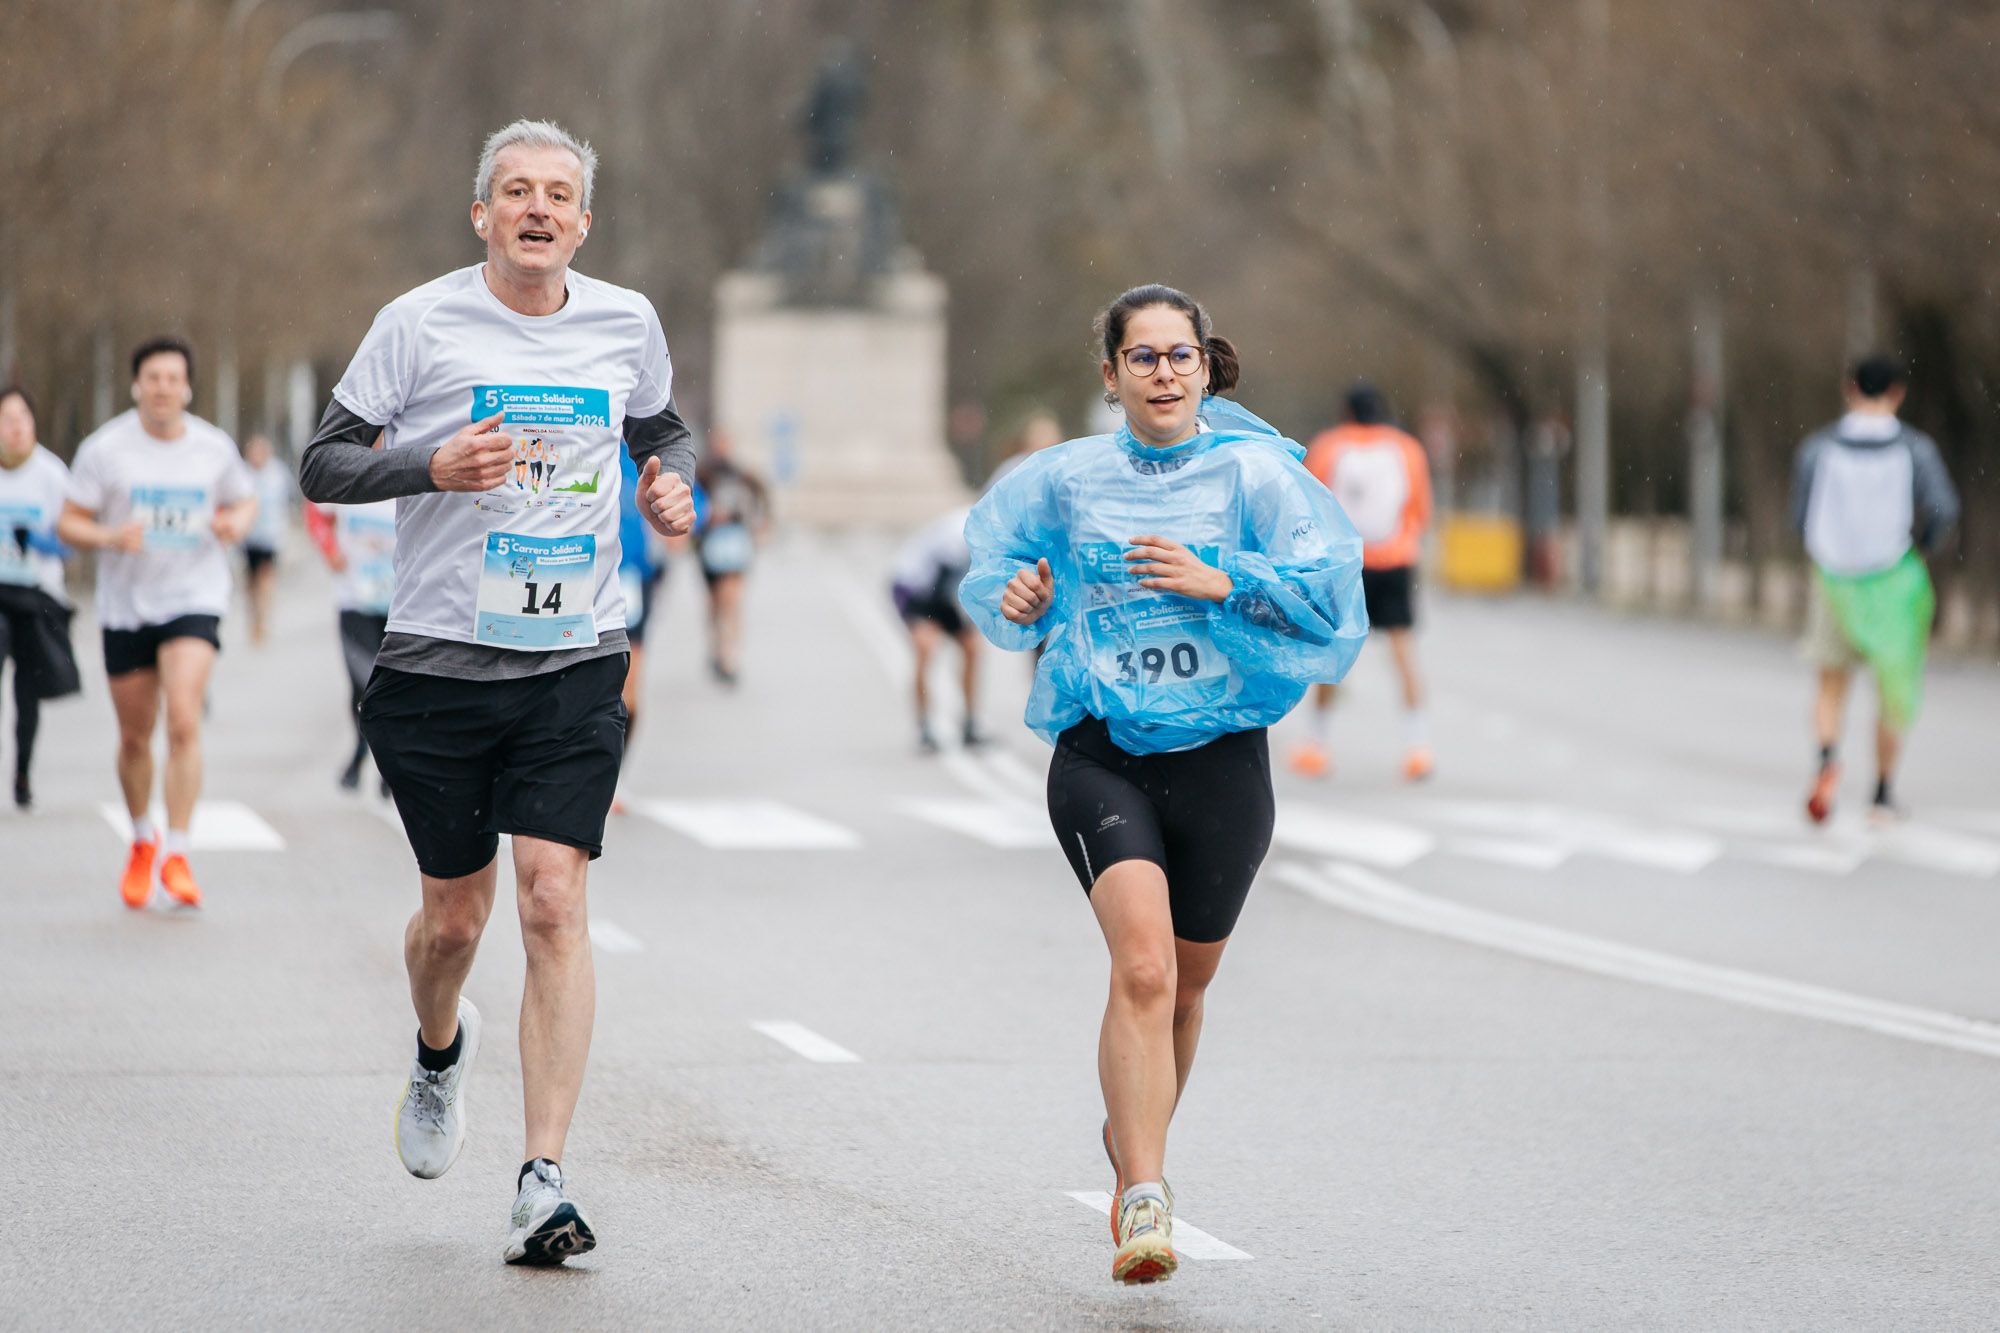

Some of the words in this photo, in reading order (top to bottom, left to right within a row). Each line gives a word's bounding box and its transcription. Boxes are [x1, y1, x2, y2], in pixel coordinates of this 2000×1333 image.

[501, 392, 540, 403] Carrera
[542, 392, 585, 404] Solidaria
[574, 413, 606, 427] 2026
[511, 542, 550, 555] Carrera
[551, 544, 583, 555] Solidaria
[521, 582, 562, 615] 14
[1149, 604, 1195, 616] Solidaria
[1115, 642, 1199, 685] 390
